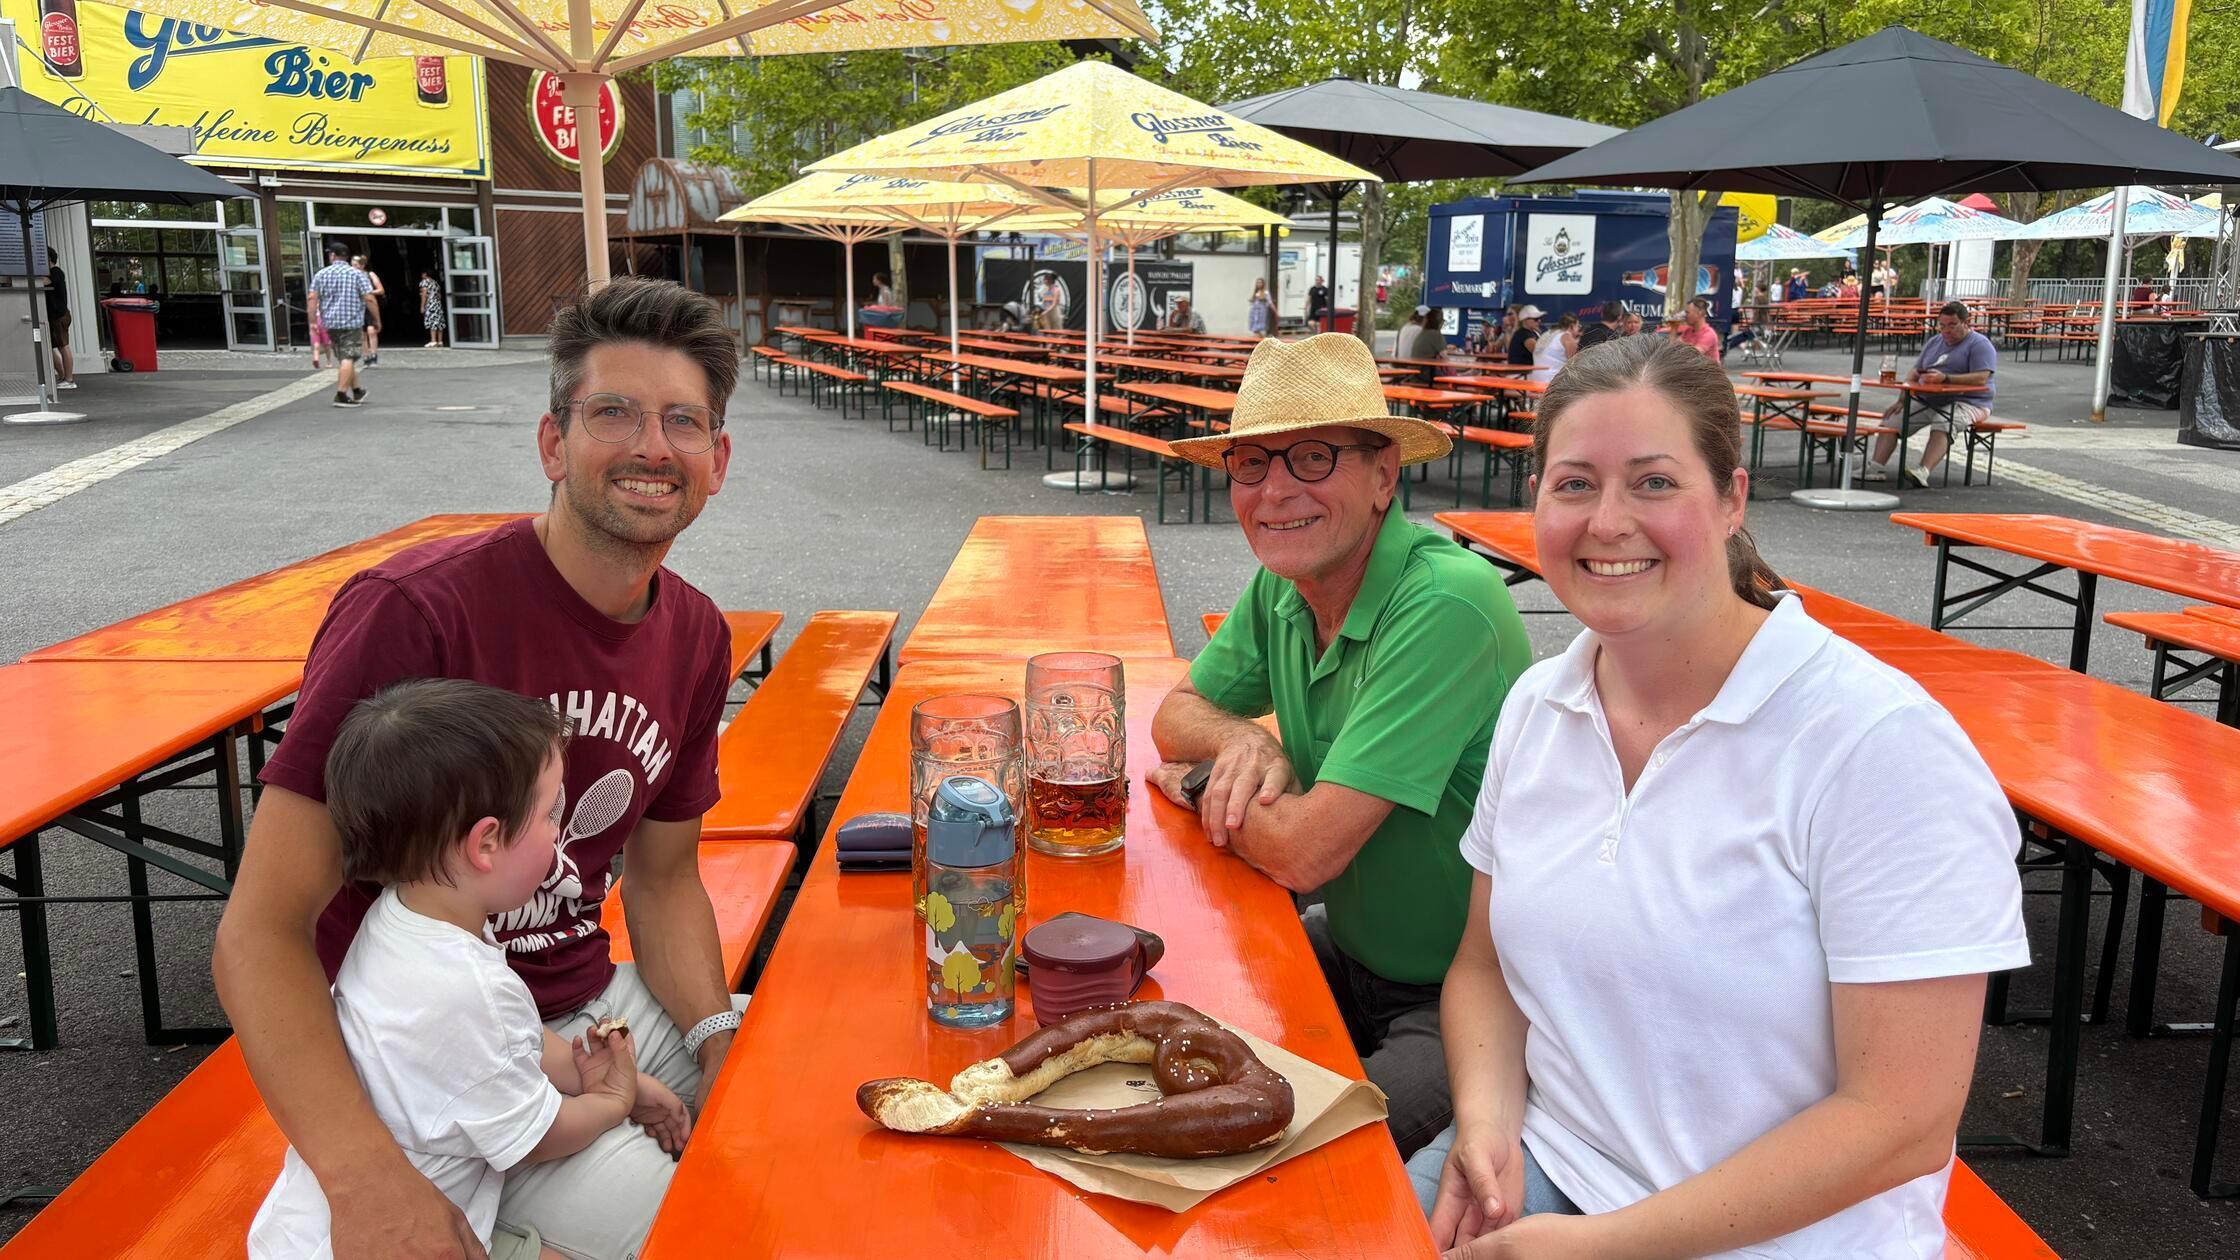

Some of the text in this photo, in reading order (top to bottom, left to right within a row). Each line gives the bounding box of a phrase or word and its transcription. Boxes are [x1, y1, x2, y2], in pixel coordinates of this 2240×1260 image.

[49, 46, 76, 58] BIER
[264, 46, 376, 102] Bier
[421, 76, 442, 87] BIER
[289, 112, 450, 160] Biergenuss
[1131, 112, 1235, 144] Glossner
[1536, 251, 1586, 283] Glossner
